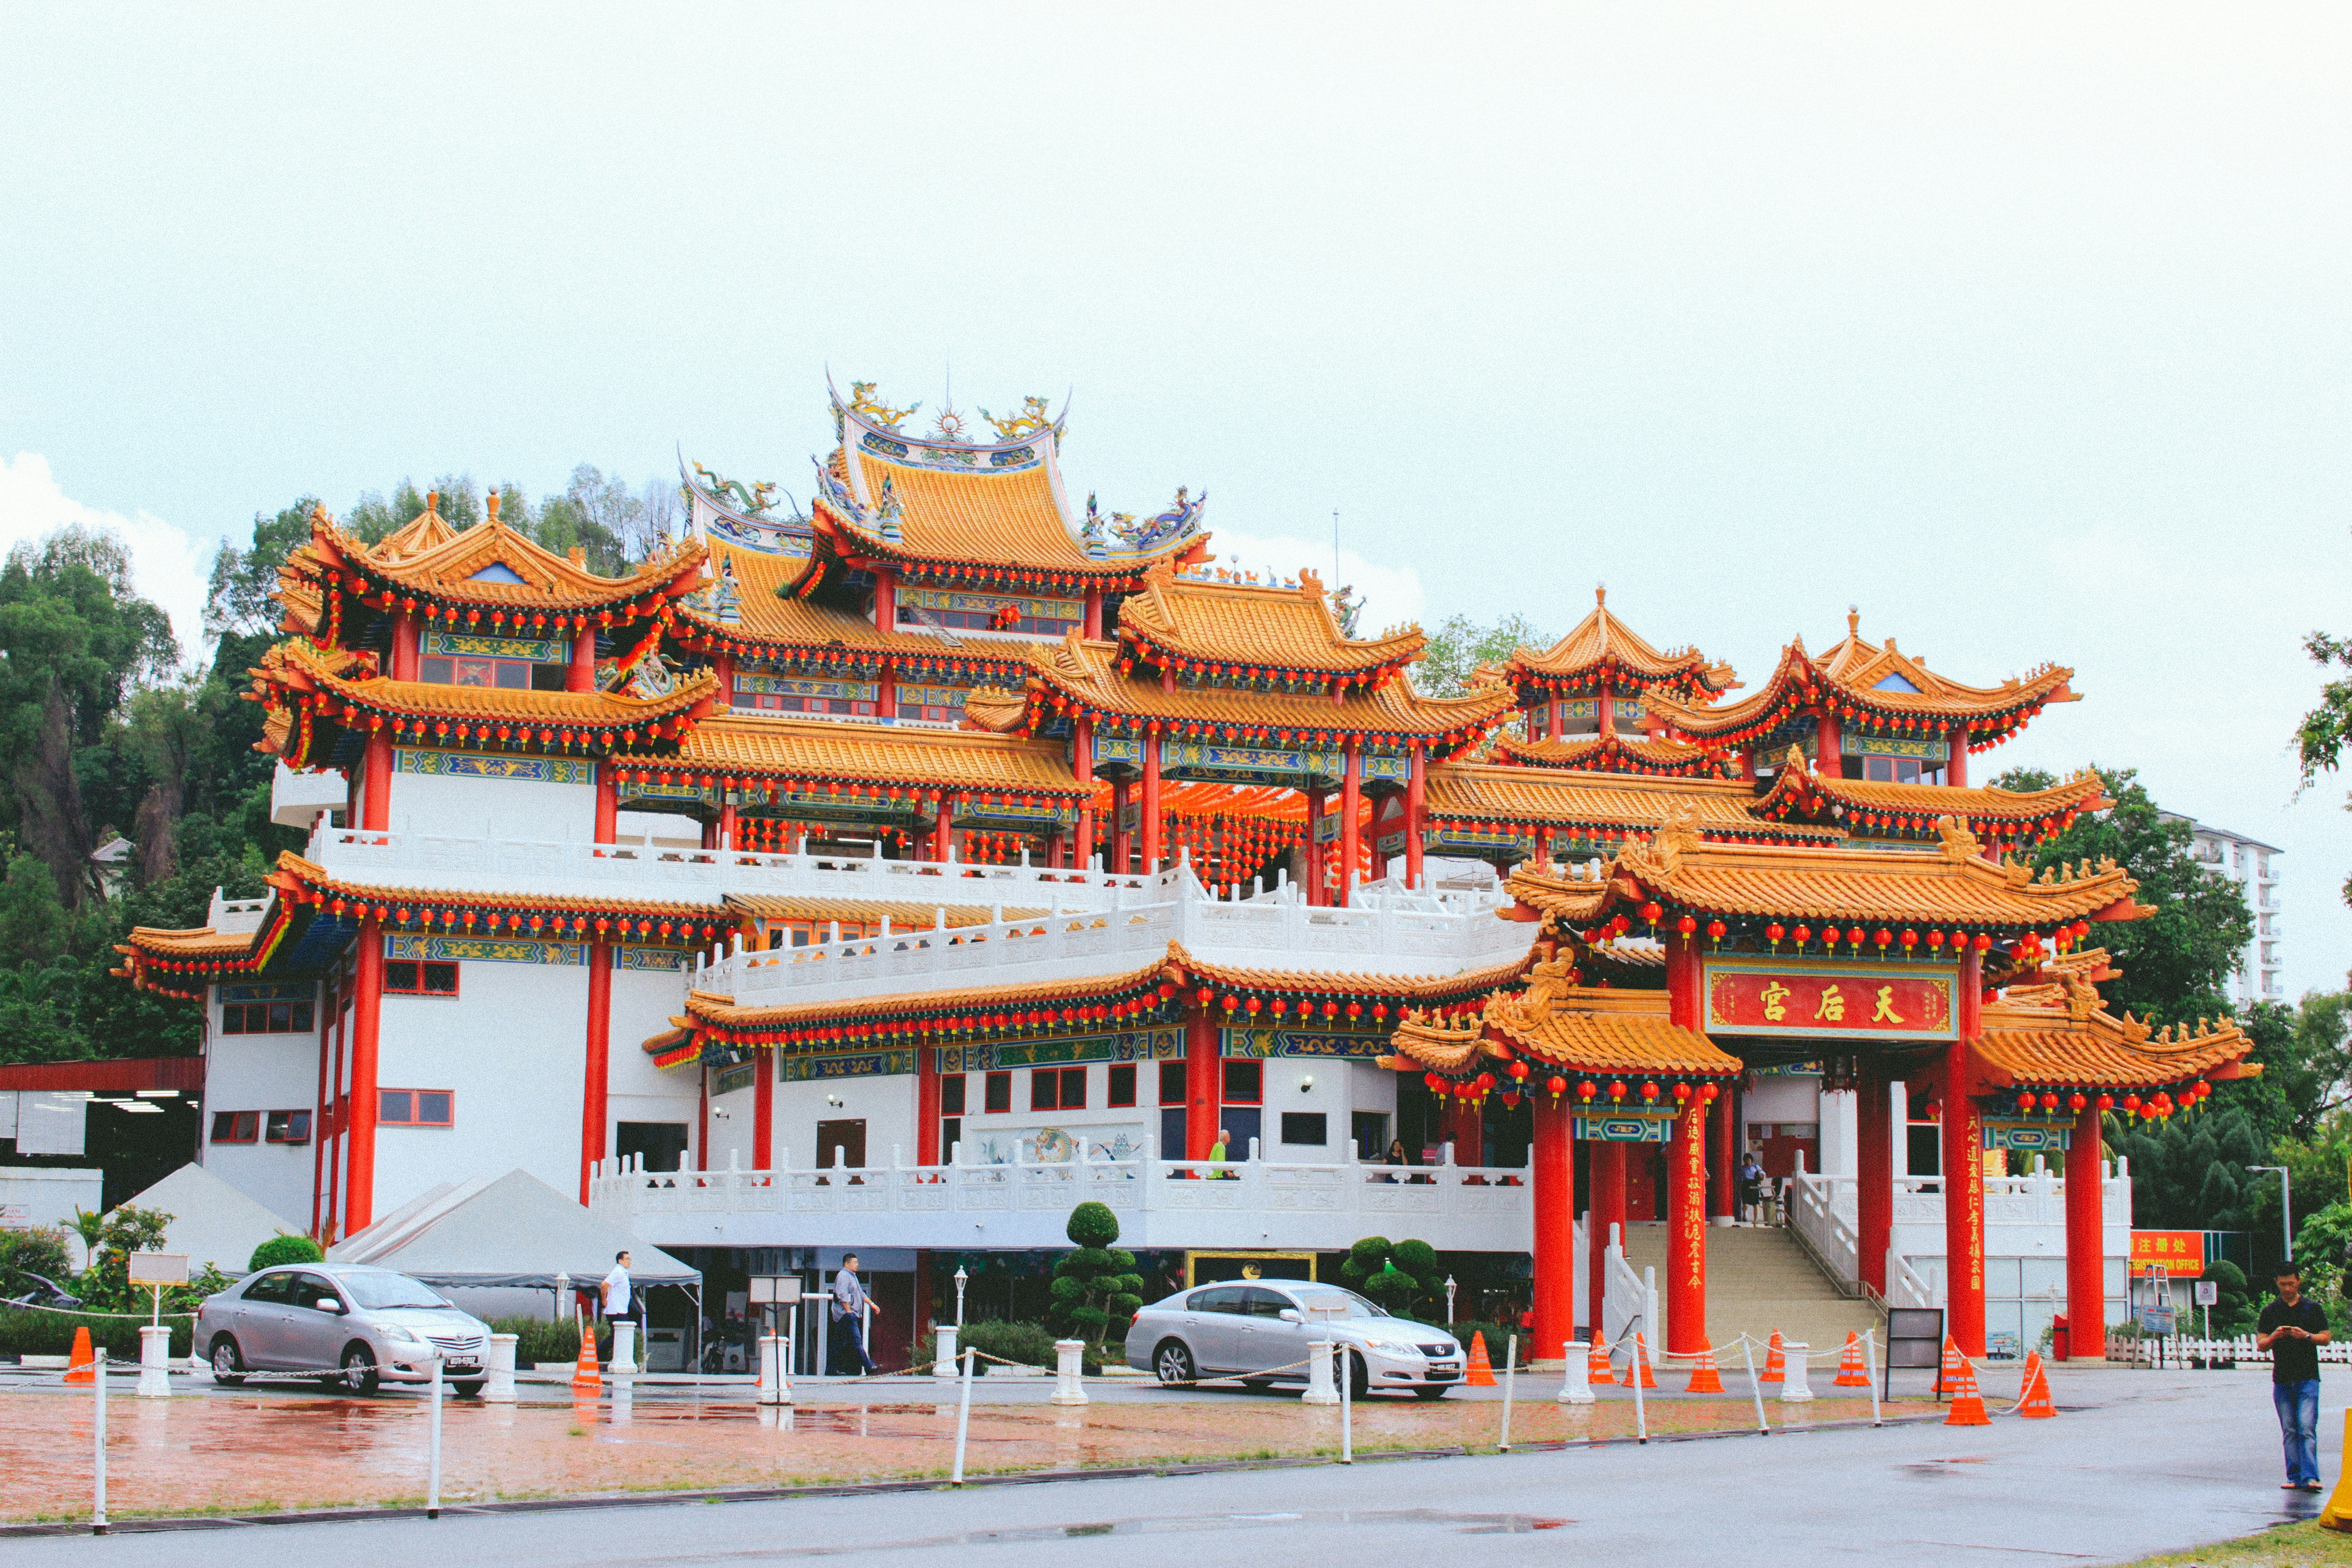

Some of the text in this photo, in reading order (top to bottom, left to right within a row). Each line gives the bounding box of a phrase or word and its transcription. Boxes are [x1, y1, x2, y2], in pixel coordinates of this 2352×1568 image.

[2131, 1237, 2186, 1252] 注册处
[2176, 1259, 2199, 1270] OFFICE
